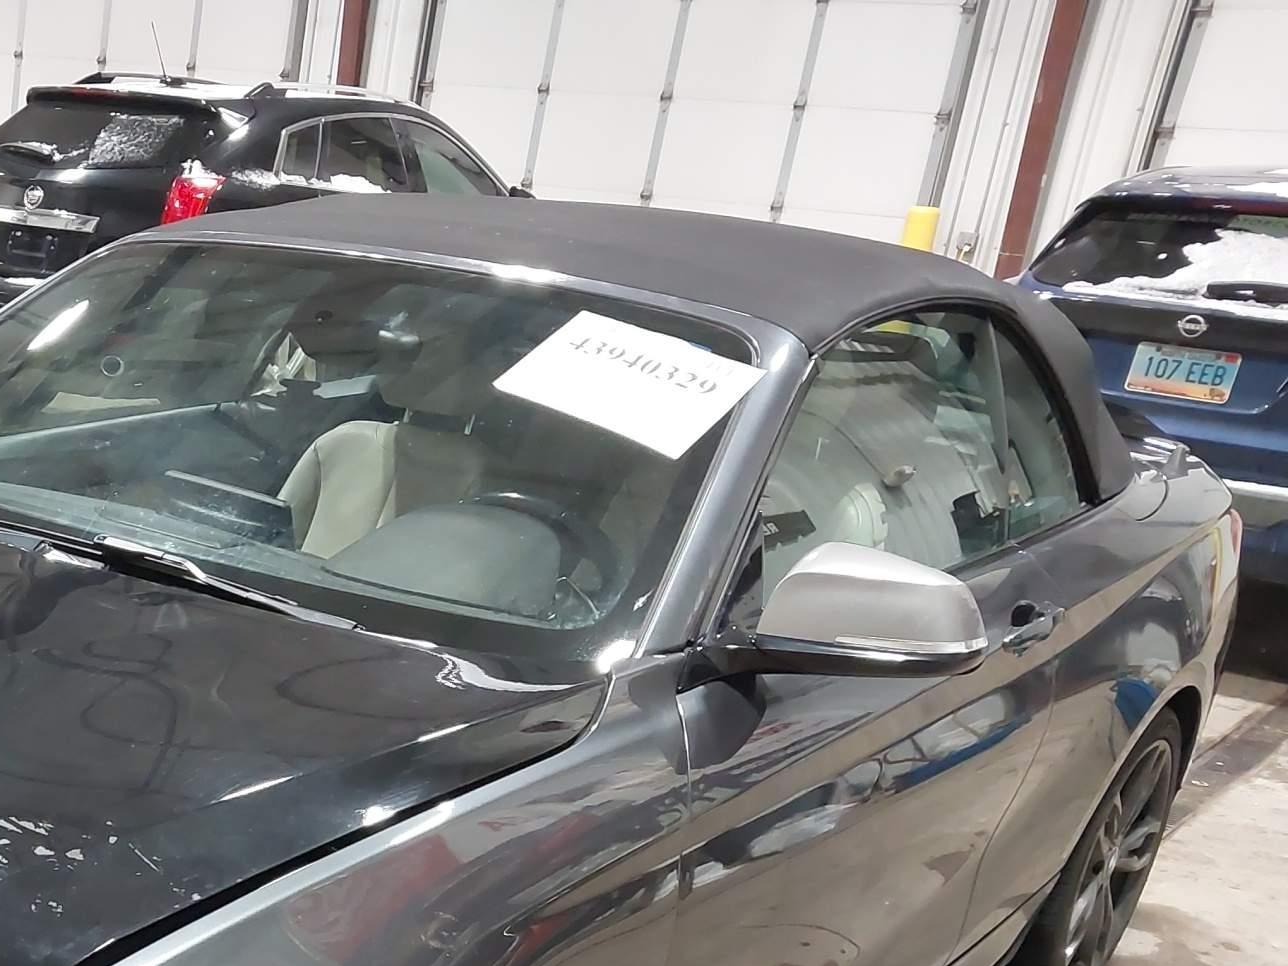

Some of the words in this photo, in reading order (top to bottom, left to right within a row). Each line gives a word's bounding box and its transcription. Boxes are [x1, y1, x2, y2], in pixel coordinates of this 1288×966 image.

[569, 337, 718, 394] 43940329
[1144, 356, 1183, 380] 107
[1185, 361, 1227, 387] EEB
